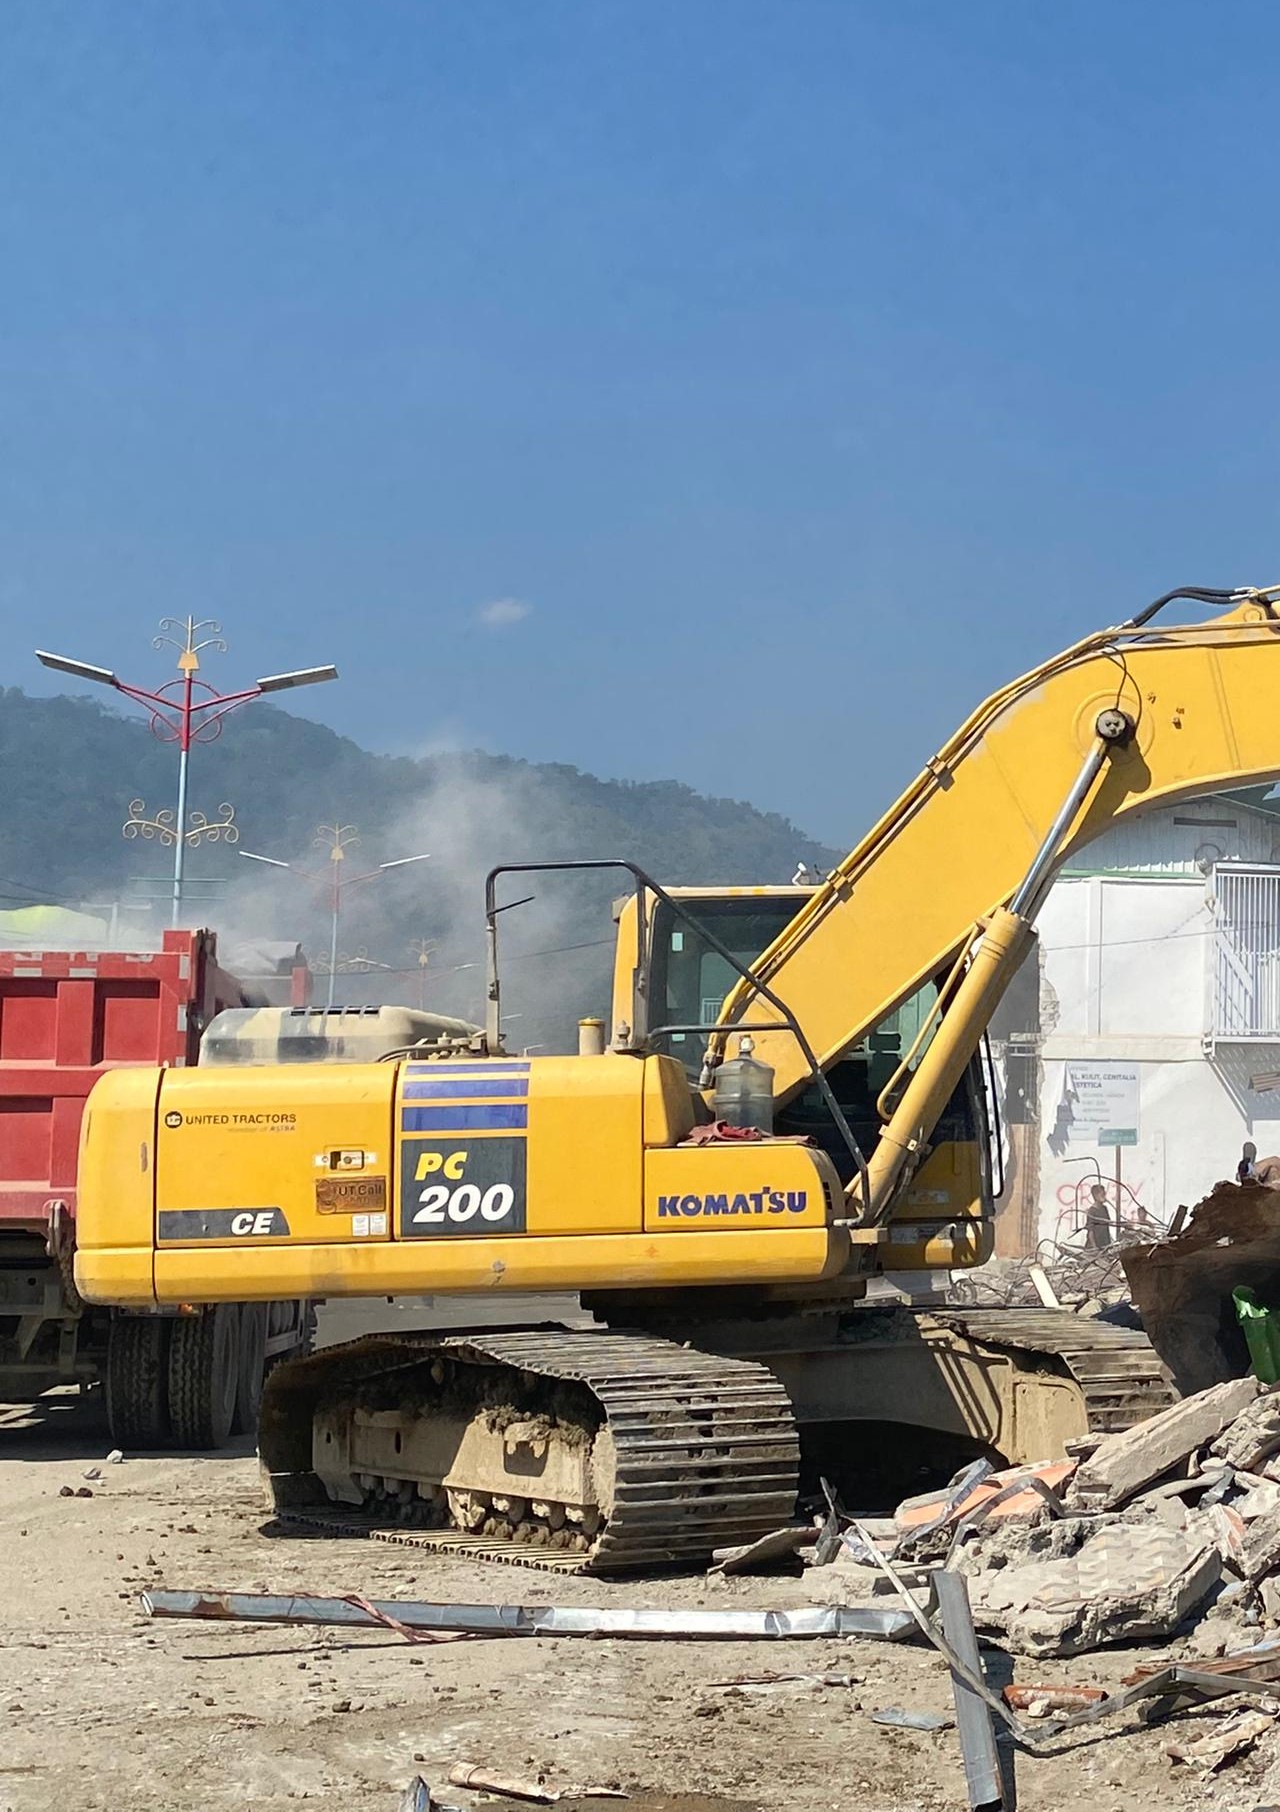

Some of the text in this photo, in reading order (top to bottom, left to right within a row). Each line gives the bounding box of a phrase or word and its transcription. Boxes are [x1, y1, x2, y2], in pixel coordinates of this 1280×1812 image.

[185, 1113, 297, 1125] UNITED TRACTORS
[414, 1151, 468, 1181] PC
[412, 1183, 515, 1223] 200
[658, 1186, 807, 1217] KOMATSU
[231, 1212, 275, 1236] CE
